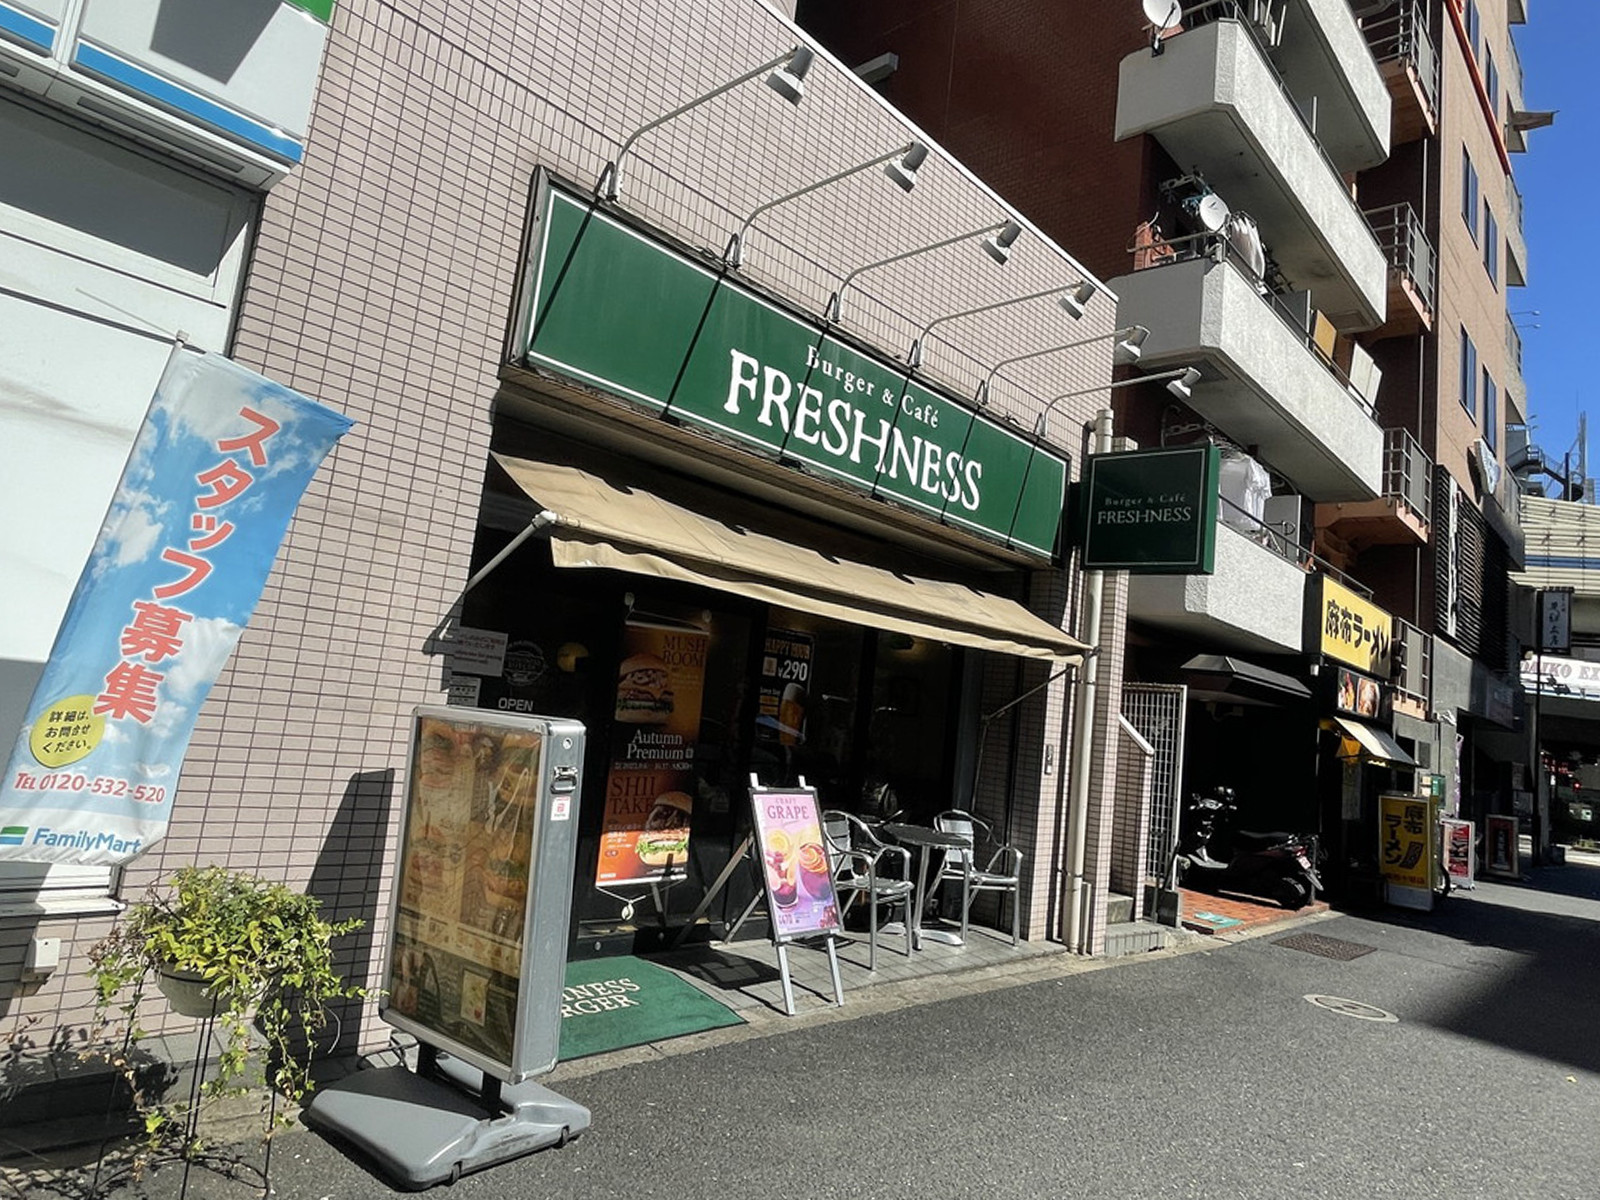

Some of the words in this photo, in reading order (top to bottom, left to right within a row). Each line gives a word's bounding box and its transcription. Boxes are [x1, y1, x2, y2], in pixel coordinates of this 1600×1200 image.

[806, 345, 876, 397] Burger
[882, 388, 894, 407] &
[901, 395, 939, 428] Café
[724, 348, 982, 511] FRESHNESS
[1104, 496, 1143, 507] Burger
[1097, 506, 1192, 525] FRESHNESS
[93, 406, 281, 725] スタッフ募集
[1325, 599, 1389, 660] 麻布ラーメン
[662, 634, 706, 652] MUSH
[498, 697, 534, 712] OPEN
[45, 724, 92, 739] お問合せ
[632, 729, 683, 745] Autumn
[42, 741, 92, 754] ください。
[626, 743, 684, 760] Premium
[15, 773, 35, 790] TEL
[39, 773, 166, 803] 0120-532-520
[611, 776, 655, 797] SHII
[767, 805, 810, 820] GRAPE
[33, 828, 142, 854] FamilyMart
[1385, 813, 1402, 865] ラーメン
